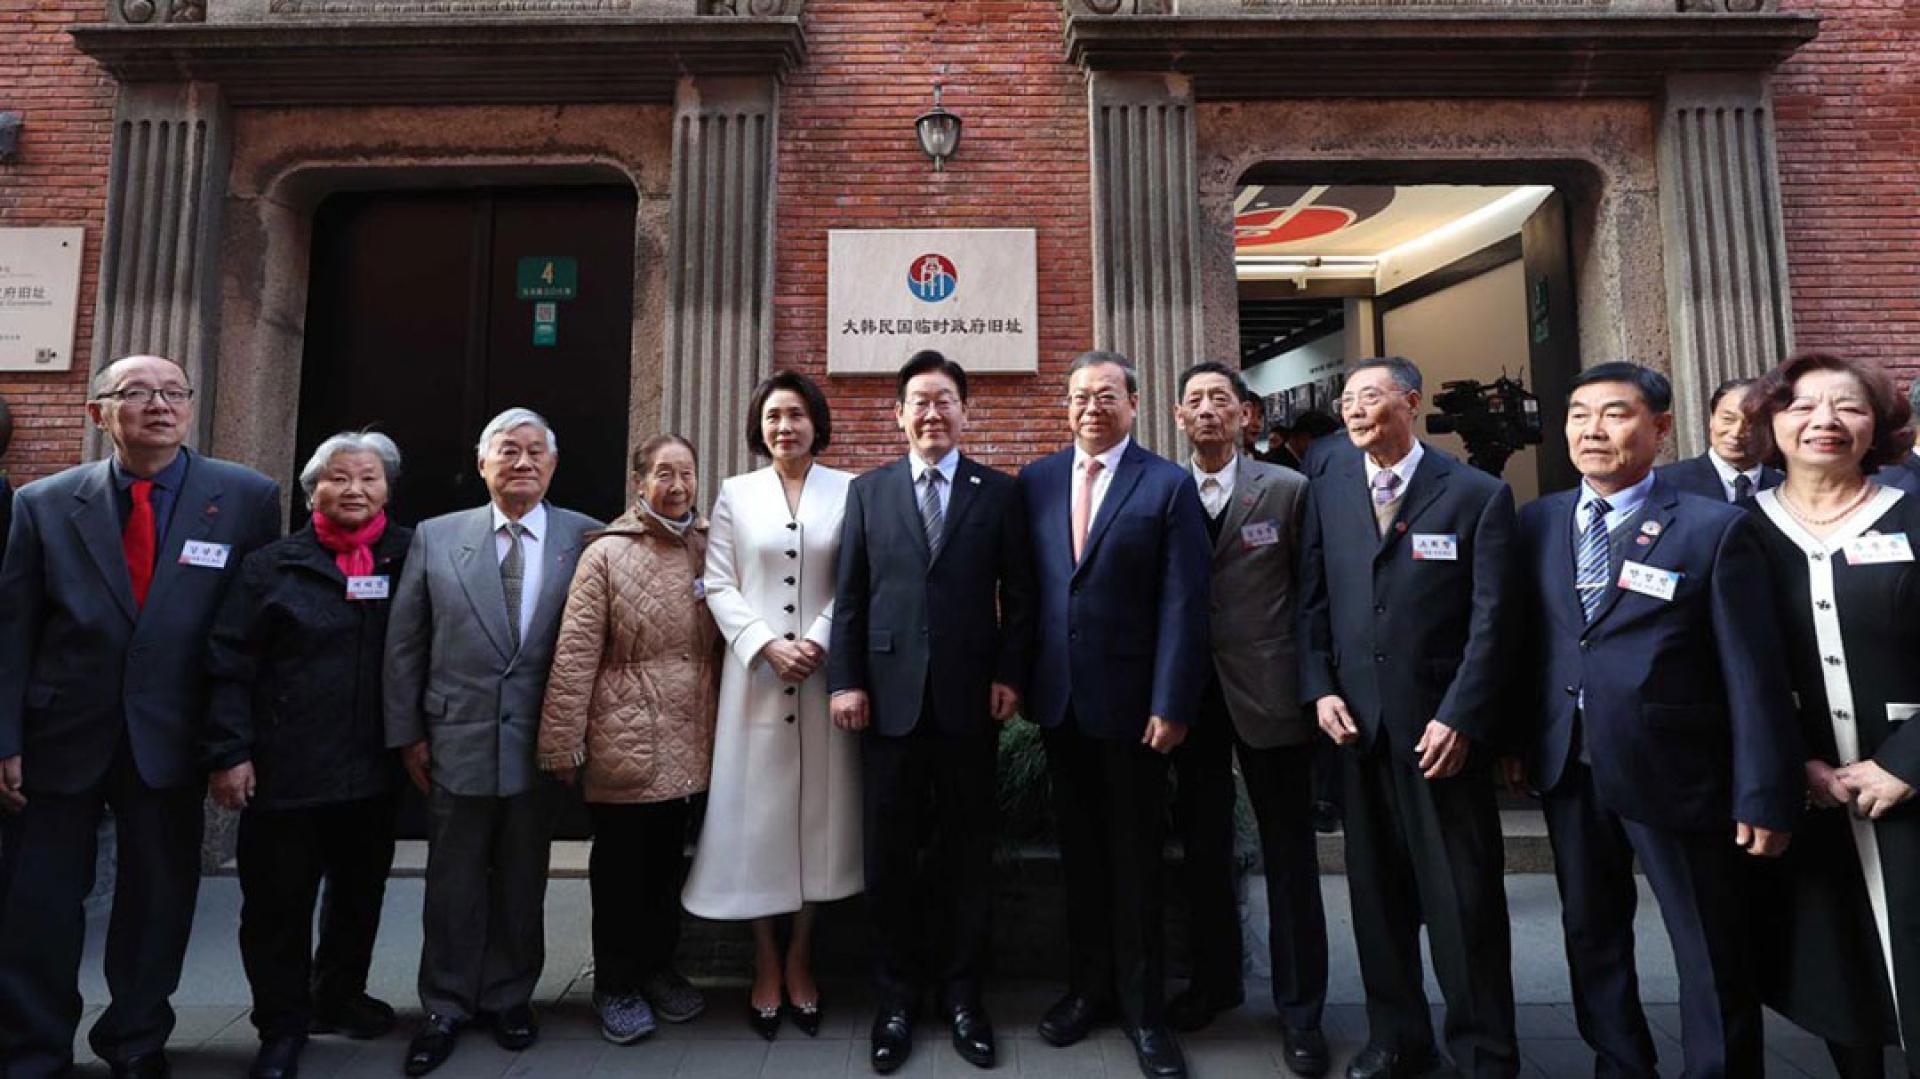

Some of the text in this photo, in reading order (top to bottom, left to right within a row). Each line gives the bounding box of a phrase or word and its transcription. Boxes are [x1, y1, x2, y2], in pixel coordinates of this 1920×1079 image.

[0, 286, 45, 299] 府旧址
[842, 317, 1023, 335] 大韩民国临时政府旧址
